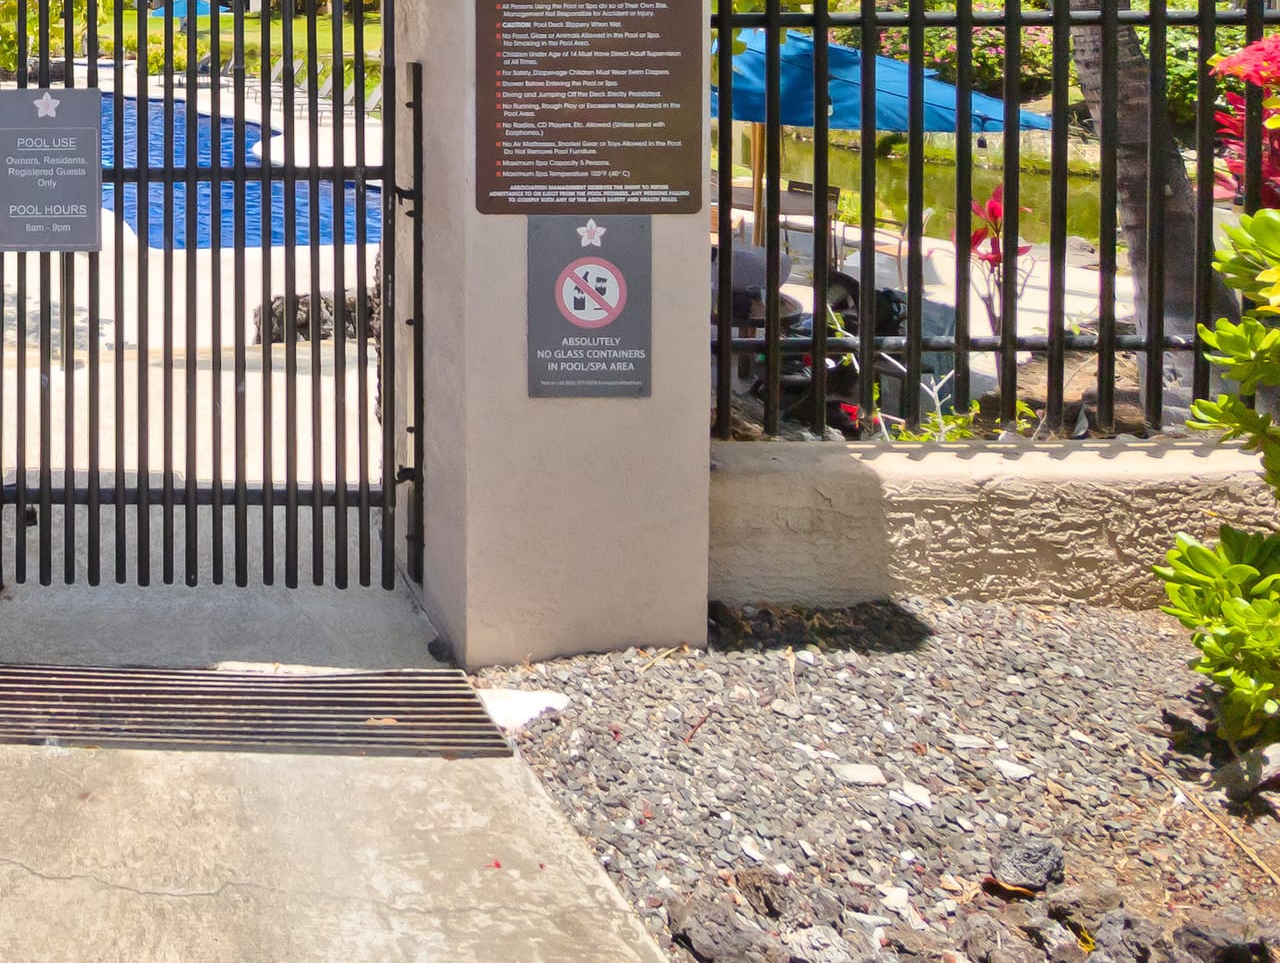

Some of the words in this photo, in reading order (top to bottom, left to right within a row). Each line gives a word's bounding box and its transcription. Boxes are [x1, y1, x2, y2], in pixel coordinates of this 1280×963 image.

[17, 138, 50, 147] POOL
[53, 138, 77, 147] USE
[6, 157, 41, 165] Owners,
[8, 168, 53, 177] Registered
[56, 168, 85, 176] Guests
[37, 179, 57, 188] Only
[10, 205, 42, 214] POOL
[44, 205, 87, 214] HOURS
[52, 224, 70, 232] 9pm
[562, 337, 620, 346] ABSOLUTELY
[537, 350, 551, 358] NO
[554, 350, 584, 358] GLASS
[586, 350, 645, 358] CONTAINERS
[548, 362, 558, 370] IN
[560, 362, 607, 370] POOL/SPA
[610, 362, 635, 370] AREA
